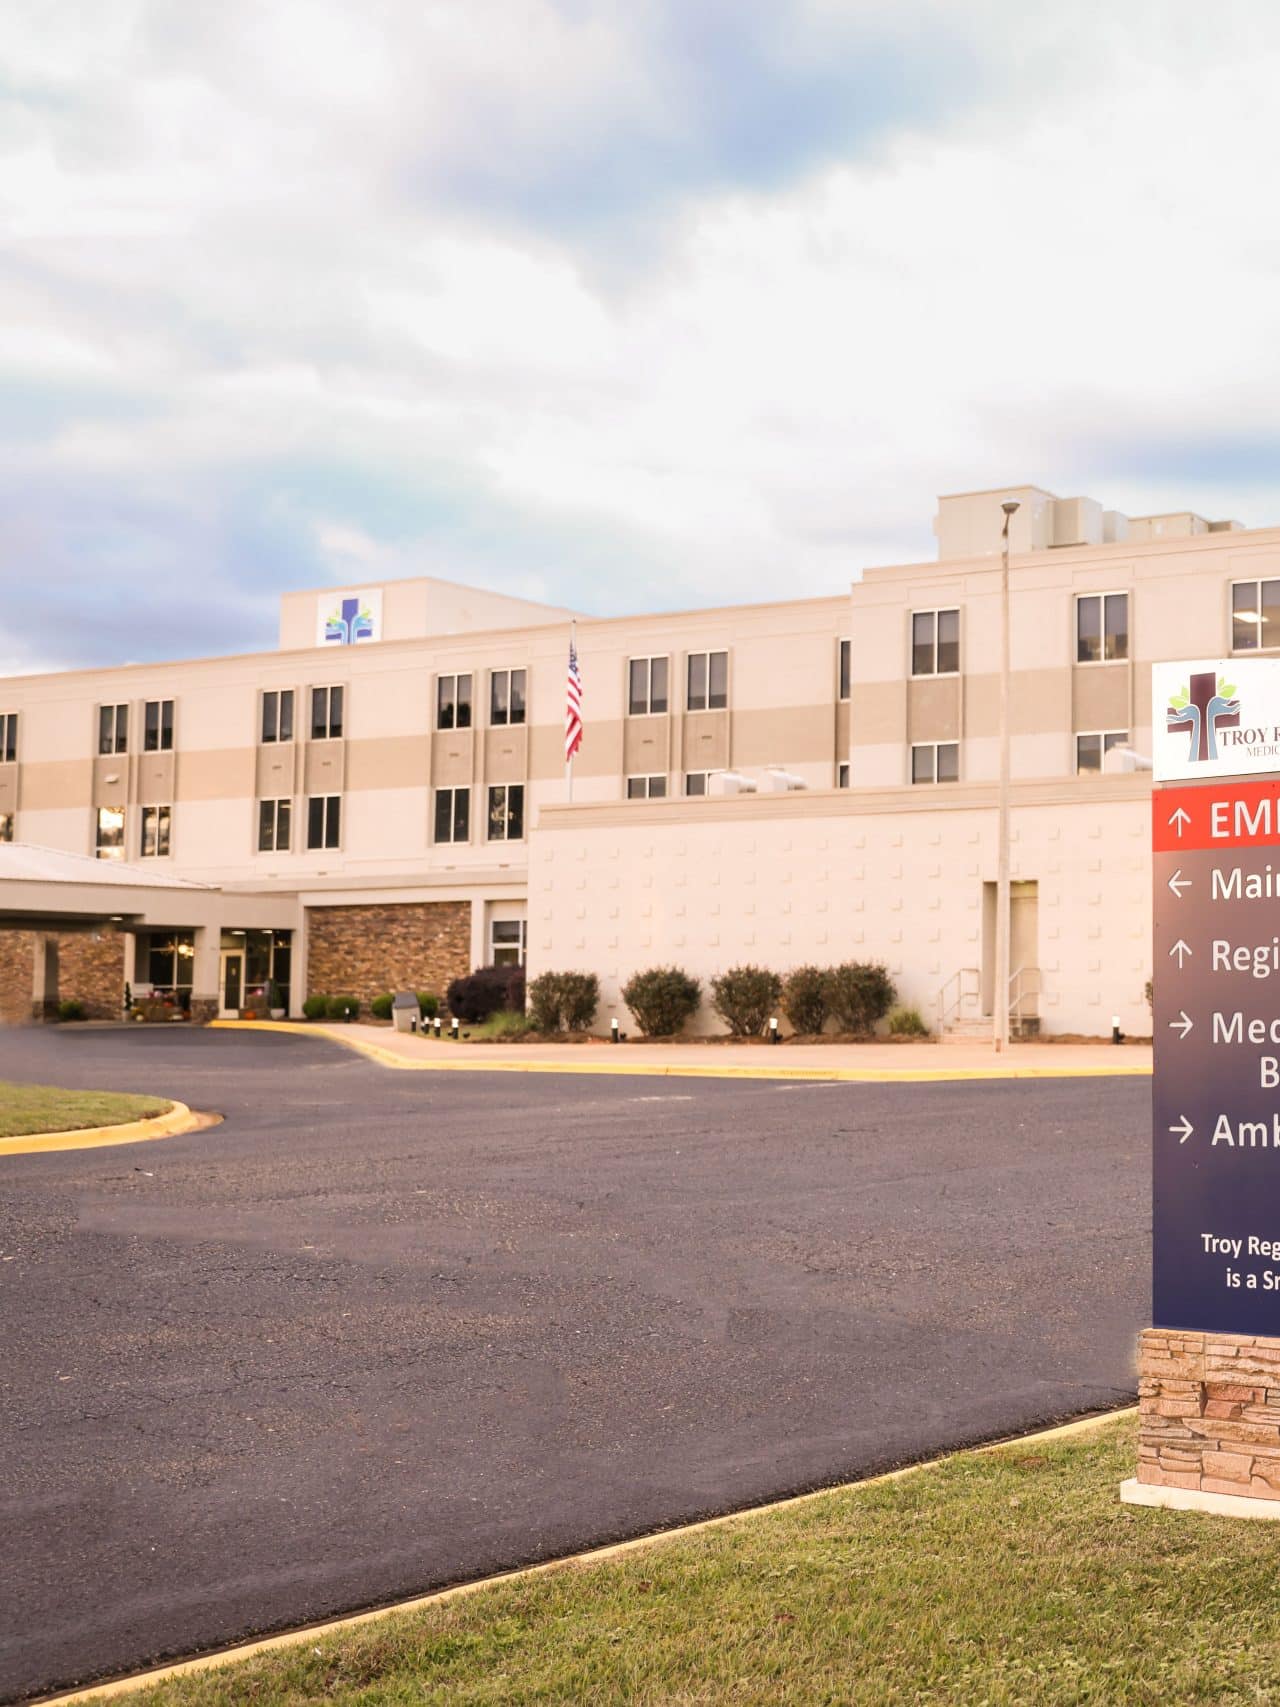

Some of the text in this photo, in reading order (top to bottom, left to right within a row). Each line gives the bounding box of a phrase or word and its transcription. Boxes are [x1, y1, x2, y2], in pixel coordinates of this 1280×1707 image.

[1219, 728, 1267, 746] TROY
[1201, 1233, 1243, 1259] Troy
[1226, 1267, 1241, 1288] is
[1246, 1274, 1257, 1289] a
